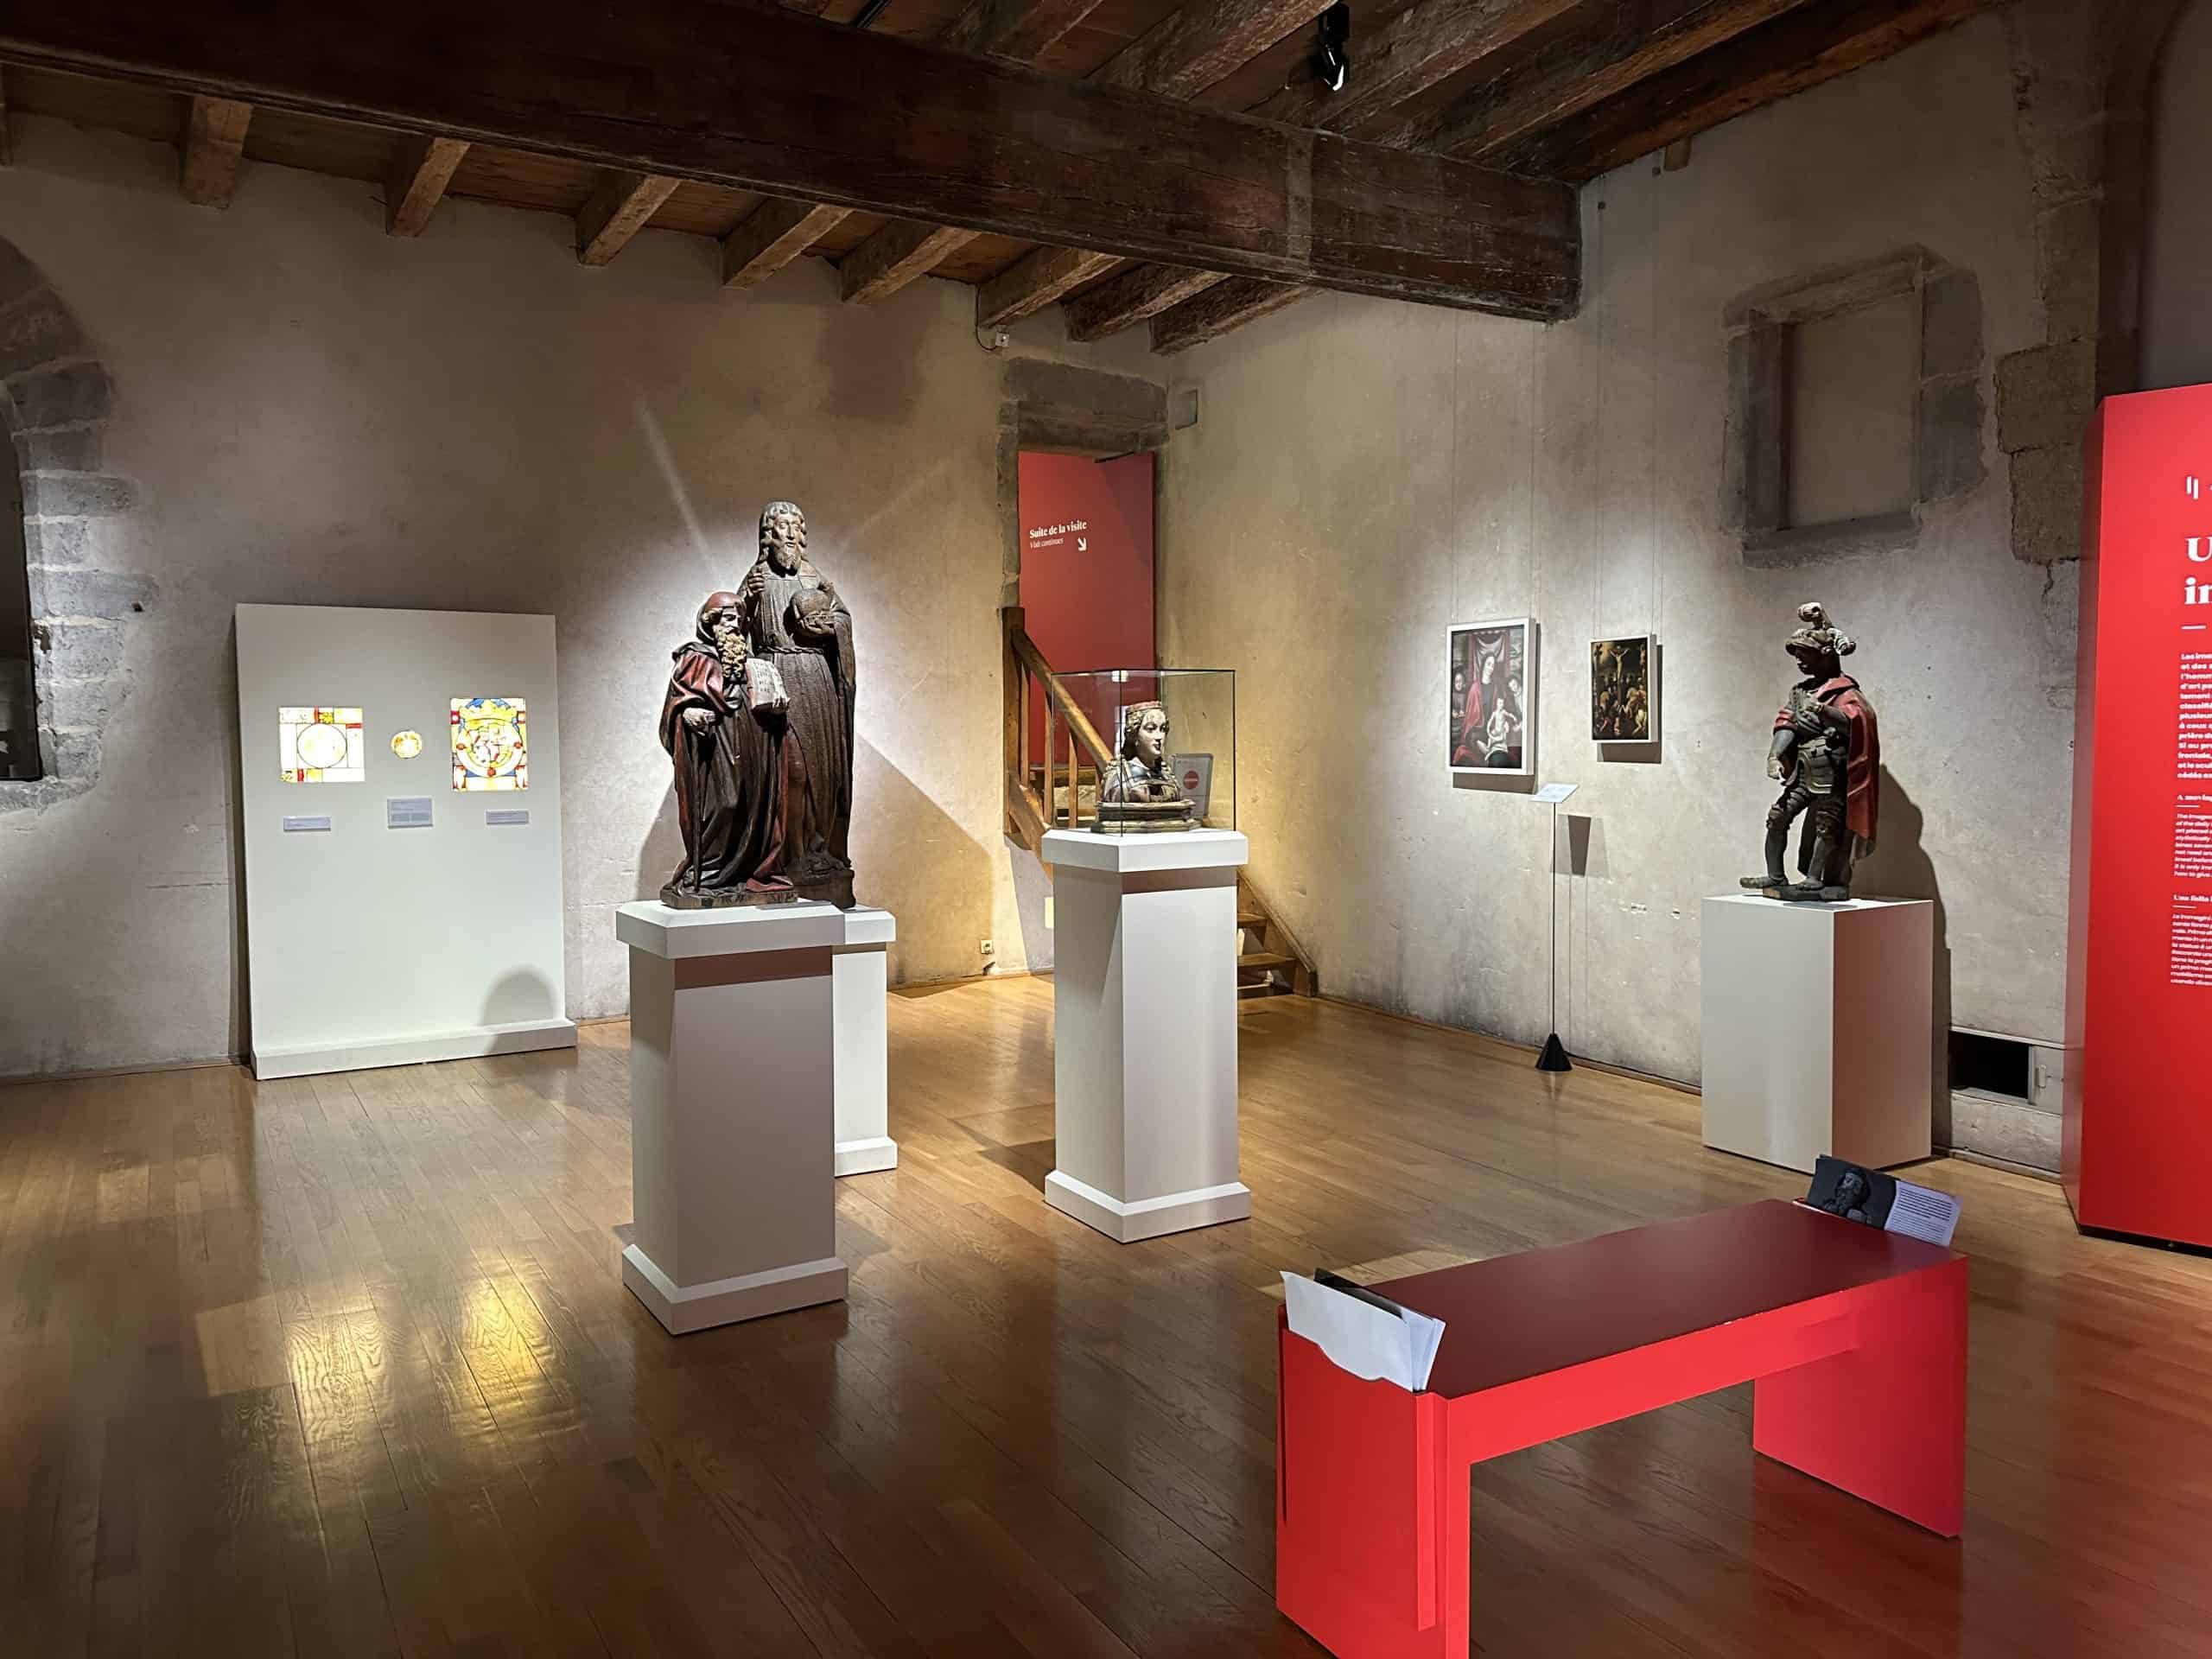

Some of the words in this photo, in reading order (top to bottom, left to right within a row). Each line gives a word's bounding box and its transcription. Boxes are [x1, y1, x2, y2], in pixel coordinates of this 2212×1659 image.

[1029, 527, 1048, 539] Suite
[1048, 525, 1058, 535] de
[1058, 524, 1065, 533] la
[1066, 520, 1087, 531] visite
